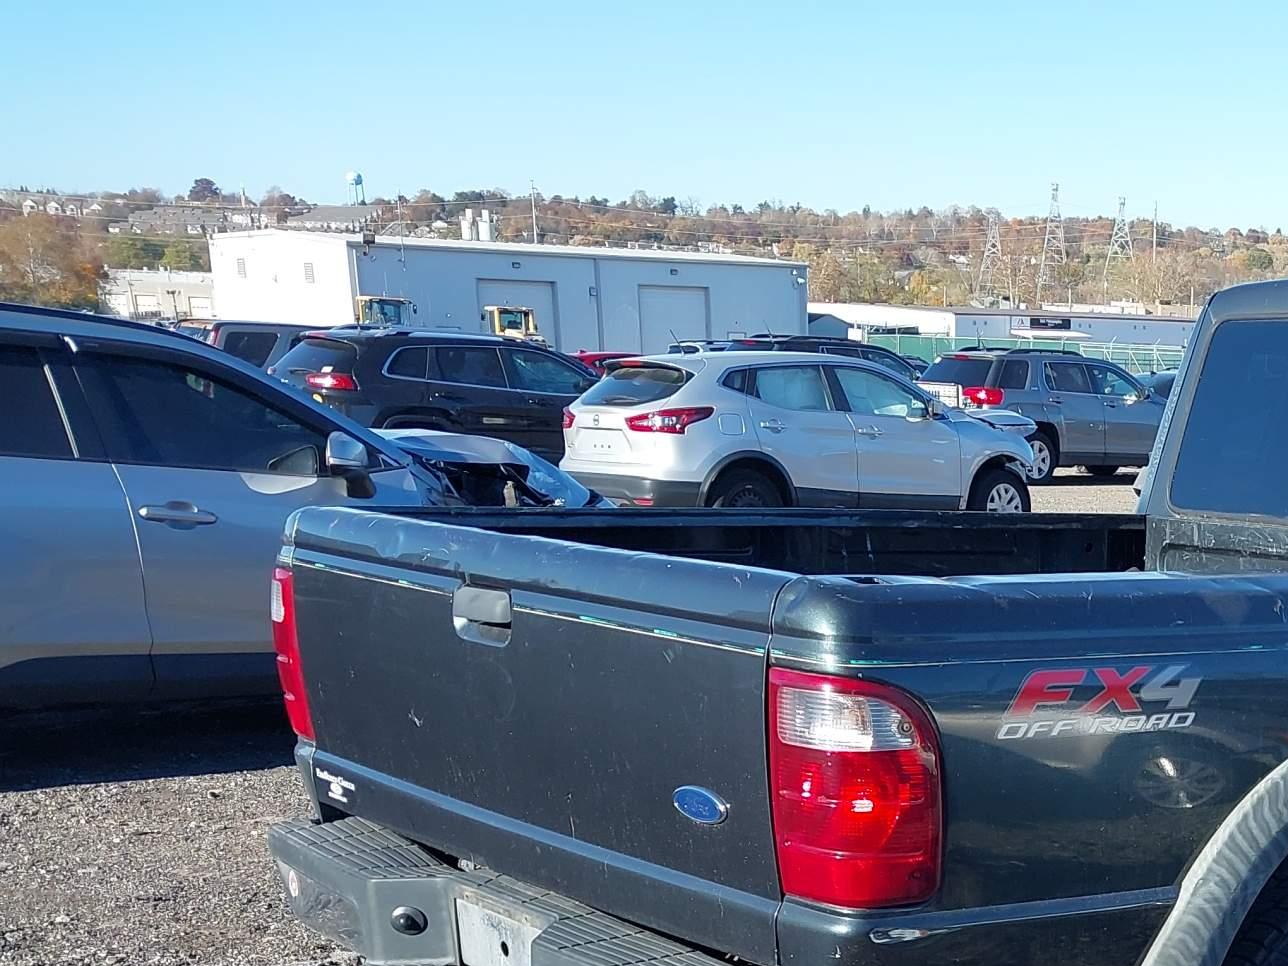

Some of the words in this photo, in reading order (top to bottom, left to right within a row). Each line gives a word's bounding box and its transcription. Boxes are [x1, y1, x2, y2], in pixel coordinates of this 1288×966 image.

[1002, 662, 1203, 718] FX4
[996, 720, 1077, 739] OFF
[1089, 712, 1196, 734] ROAD
